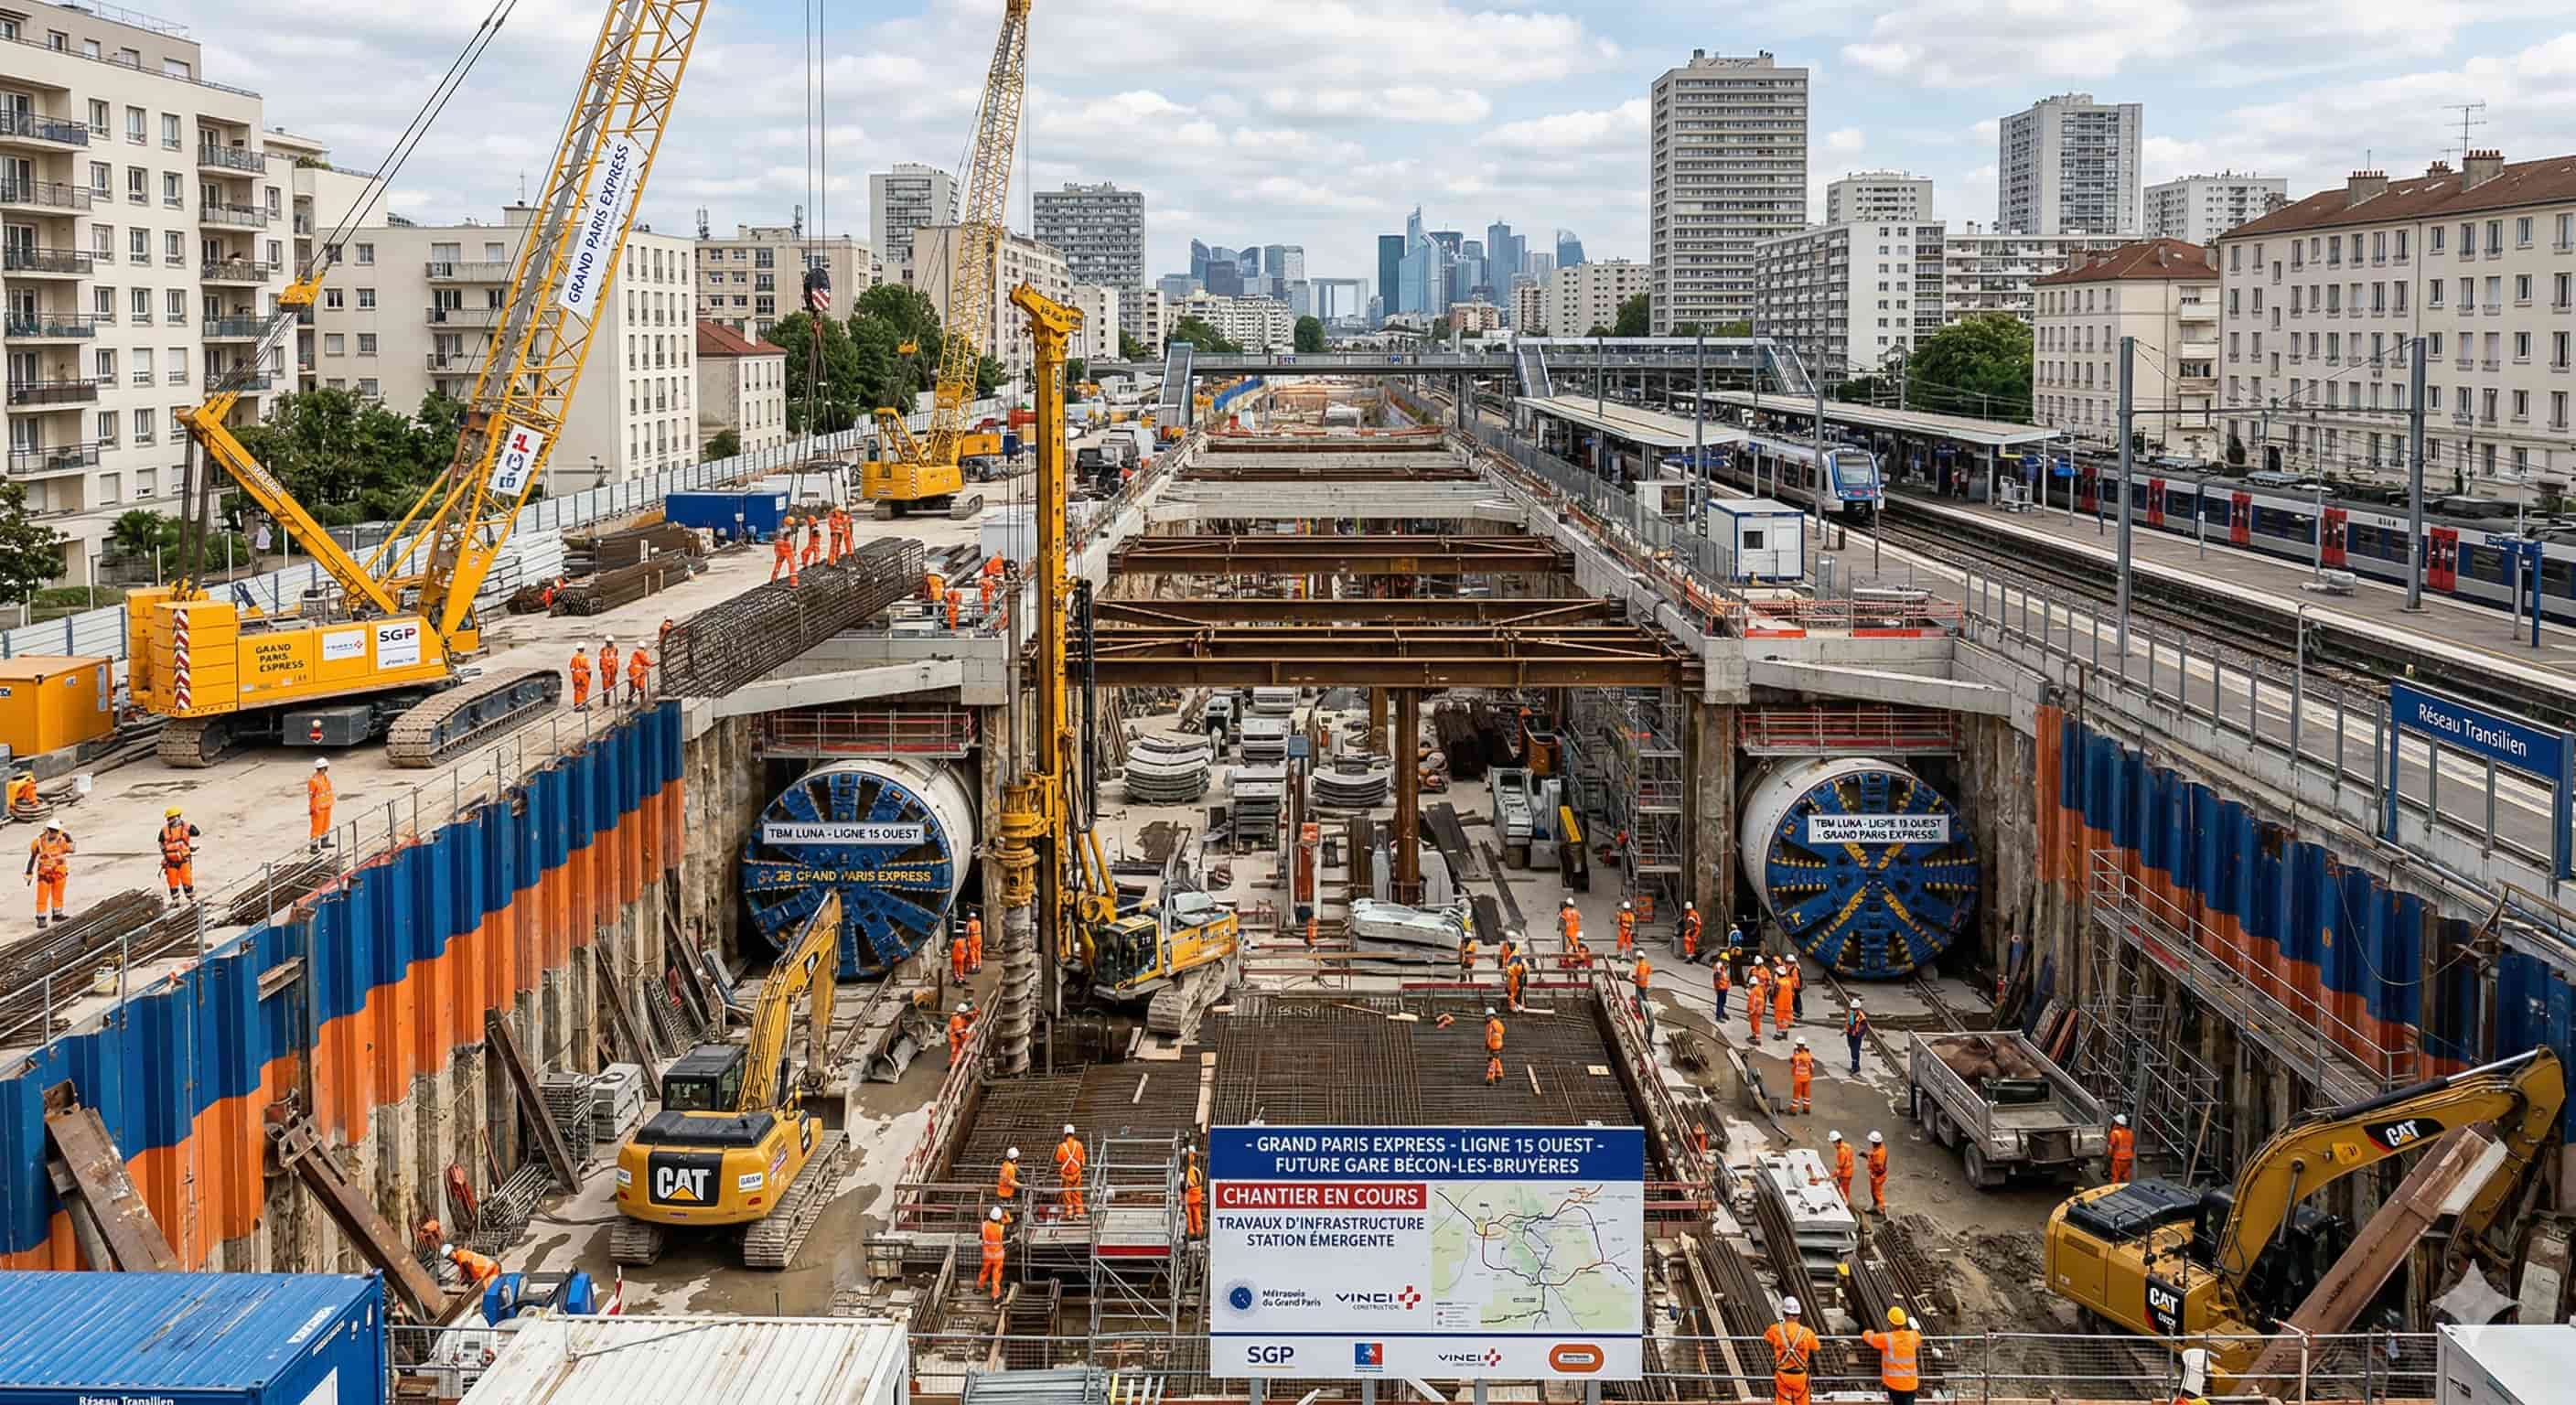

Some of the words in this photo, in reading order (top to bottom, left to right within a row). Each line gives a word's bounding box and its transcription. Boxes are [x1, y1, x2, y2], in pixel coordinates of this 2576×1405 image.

[569, 252, 594, 303] GRAND
[585, 208, 608, 250] PARIS
[600, 144, 629, 207] EXPRESS
[380, 627, 416, 642] SGP
[2419, 703, 2461, 733] Réseau
[2463, 718, 2528, 757] Transilien
[768, 829, 792, 839] TBM
[796, 829, 824, 839] LUNA
[834, 829, 865, 839] LIGNE
[883, 829, 919, 839] OUEST
[877, 871, 931, 882] EXPRESS
[2386, 1120, 2420, 1146] CAT
[1257, 1137, 1316, 1153] GRAND
[1322, 1137, 1368, 1153] PARIS
[1374, 1137, 1445, 1153] EXPRESS
[1461, 1137, 1510, 1153] LIGNE
[1515, 1138, 1533, 1153] 15
[1539, 1138, 1594, 1153] OUEST
[1276, 1157, 1340, 1173] FUTURE
[1345, 1157, 1390, 1173] GARE
[1394, 1154, 1579, 1174] BÉCON-LES-BRUYÈRES
[657, 1166, 710, 1201] CAT
[1223, 1187, 1318, 1205] CHANTIER
[1325, 1188, 1349, 1205] EN
[1354, 1187, 1418, 1206] COURS
[1218, 1217, 1282, 1229] TRAVAUX
[1286, 1217, 1423, 1229] D'INFRASTRUCTURE
[1247, 1234, 1306, 1247] STATION
[1310, 1230, 1394, 1247] ÉMERGENTE
[1262, 1298, 1273, 1307] du
[1274, 1298, 1301, 1307] Grand
[1302, 1298, 1321, 1307] Paris
[1336, 1292, 1393, 1303] VINCI
[2150, 1288, 2179, 1315] CAT
[1247, 1346, 1294, 1364] SGP
[1438, 1354, 1481, 1362] VINCI
